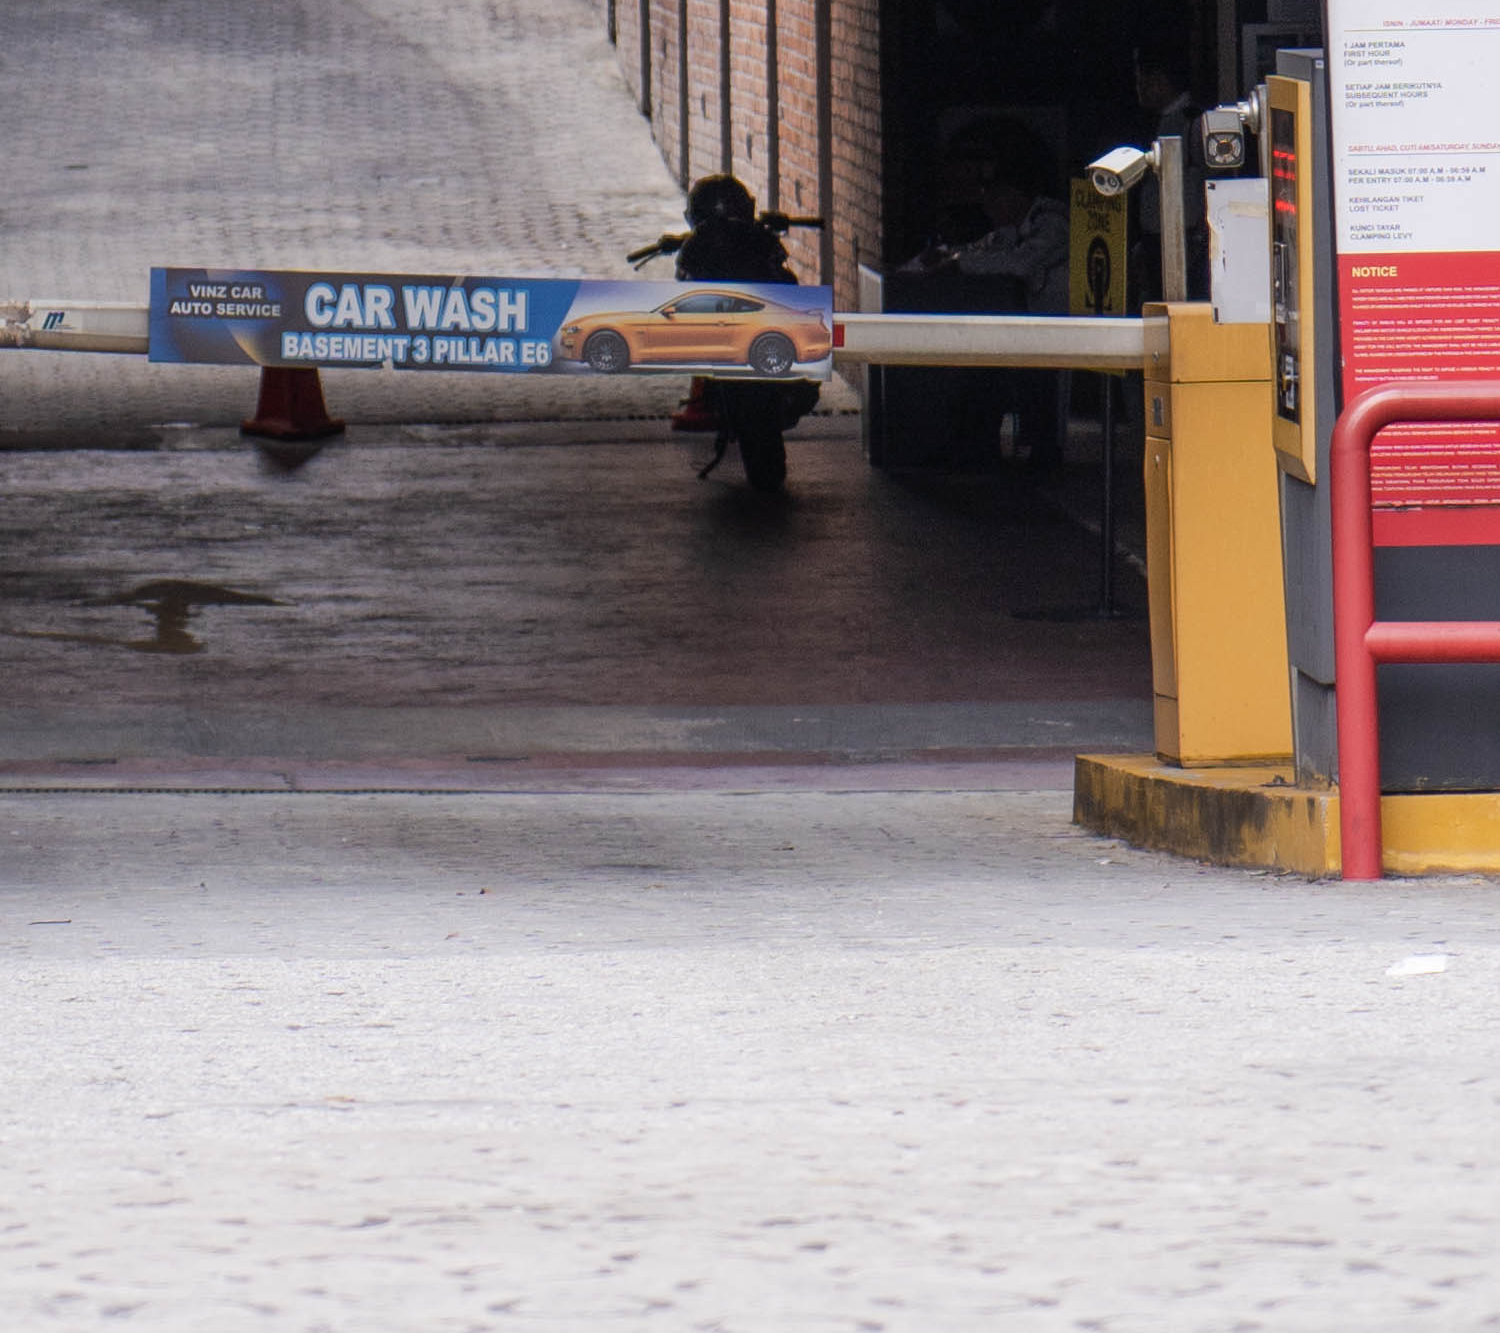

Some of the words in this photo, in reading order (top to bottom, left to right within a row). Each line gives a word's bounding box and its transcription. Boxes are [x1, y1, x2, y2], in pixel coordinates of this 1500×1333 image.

[1352, 267, 1397, 277] NOTICE
[190, 285, 226, 298] VINZ
[231, 286, 261, 299] CAR
[171, 302, 213, 315] AUTO
[216, 303, 281, 316] SERVICE
[306, 283, 392, 327] CAR
[403, 287, 526, 331] WASH
[283, 335, 408, 359] BASEMENT
[414, 338, 427, 361] 3
[434, 338, 514, 363] PILLAR
[522, 341, 548, 364] E6
